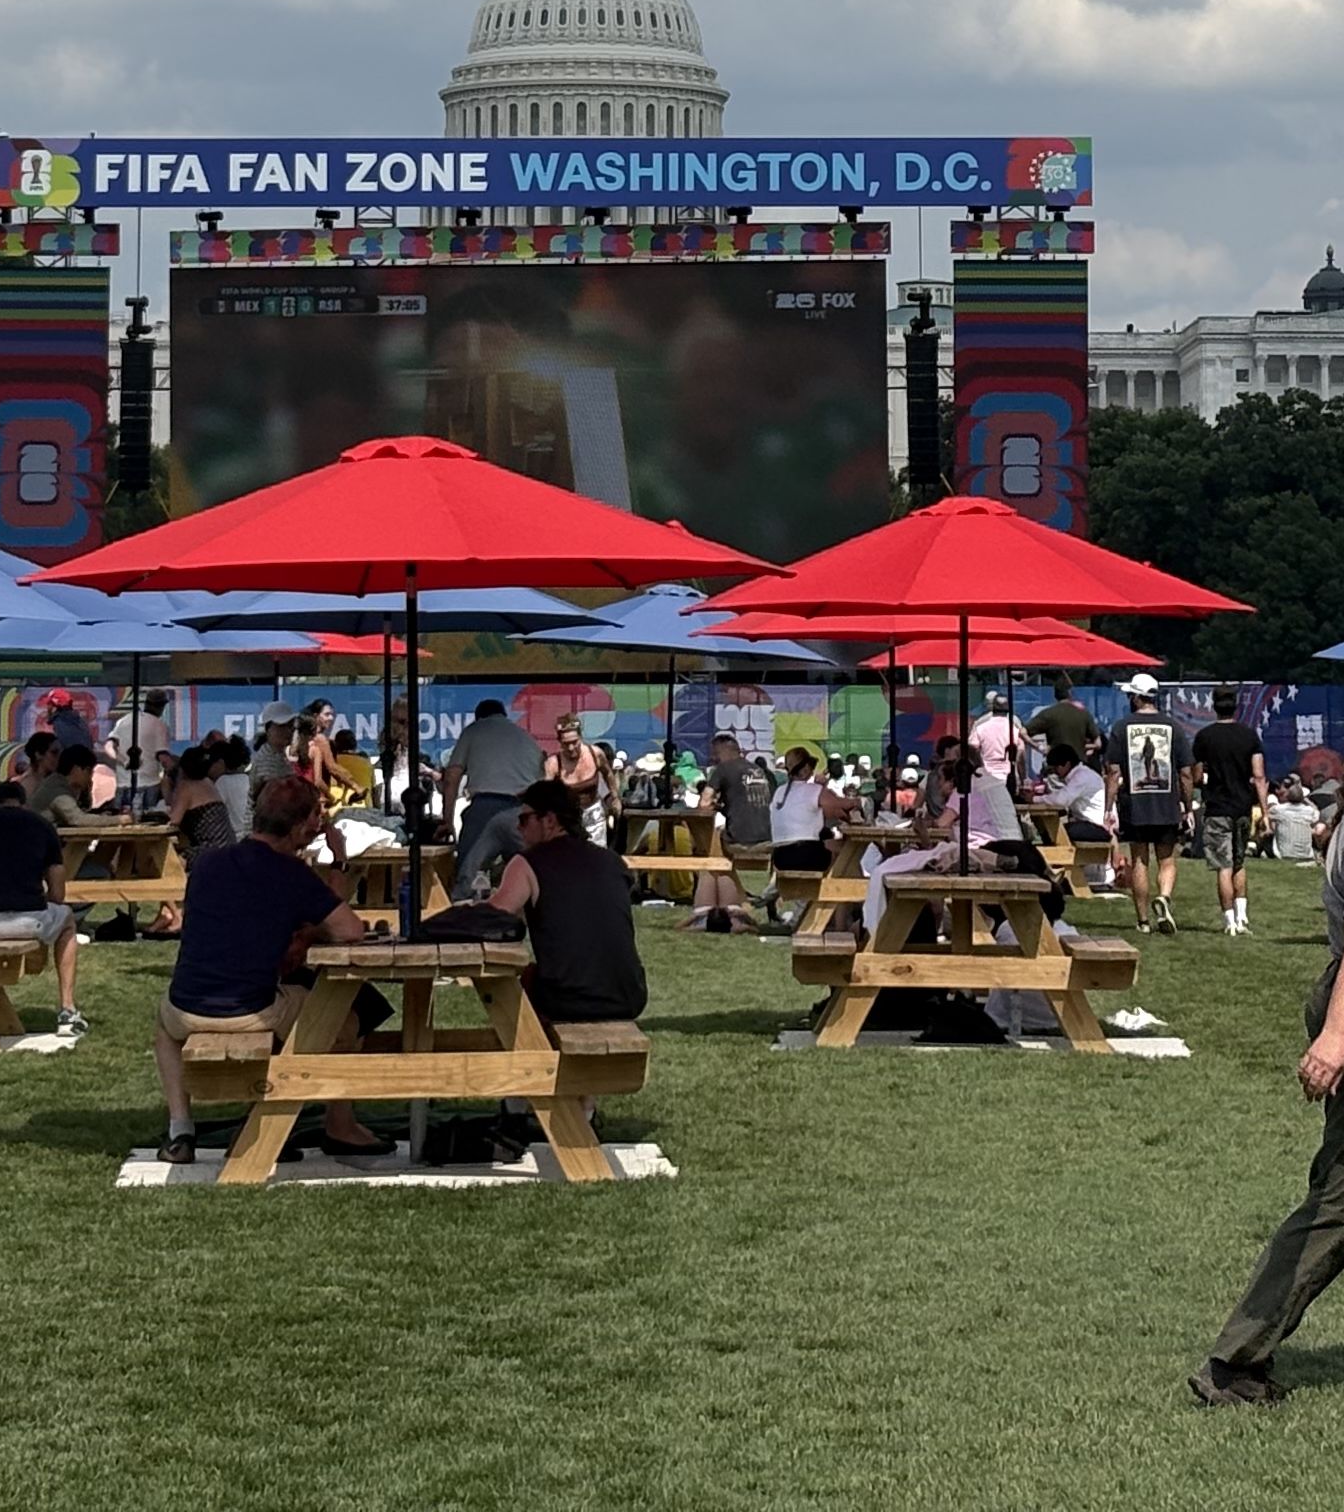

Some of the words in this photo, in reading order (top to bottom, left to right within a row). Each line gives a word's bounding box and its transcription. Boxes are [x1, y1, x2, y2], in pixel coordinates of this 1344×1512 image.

[95, 152, 211, 194] FIFA
[229, 152, 329, 193] FAN
[345, 152, 489, 193] ZONE
[509, 151, 881, 199] WASHINGTON,
[896, 151, 992, 193] D.C.
[234, 299, 260, 313] MEX
[301, 300, 311, 312] 0
[318, 299, 342, 313] RSA
[821, 292, 856, 309] FOX
[805, 310, 827, 320] LIVE
